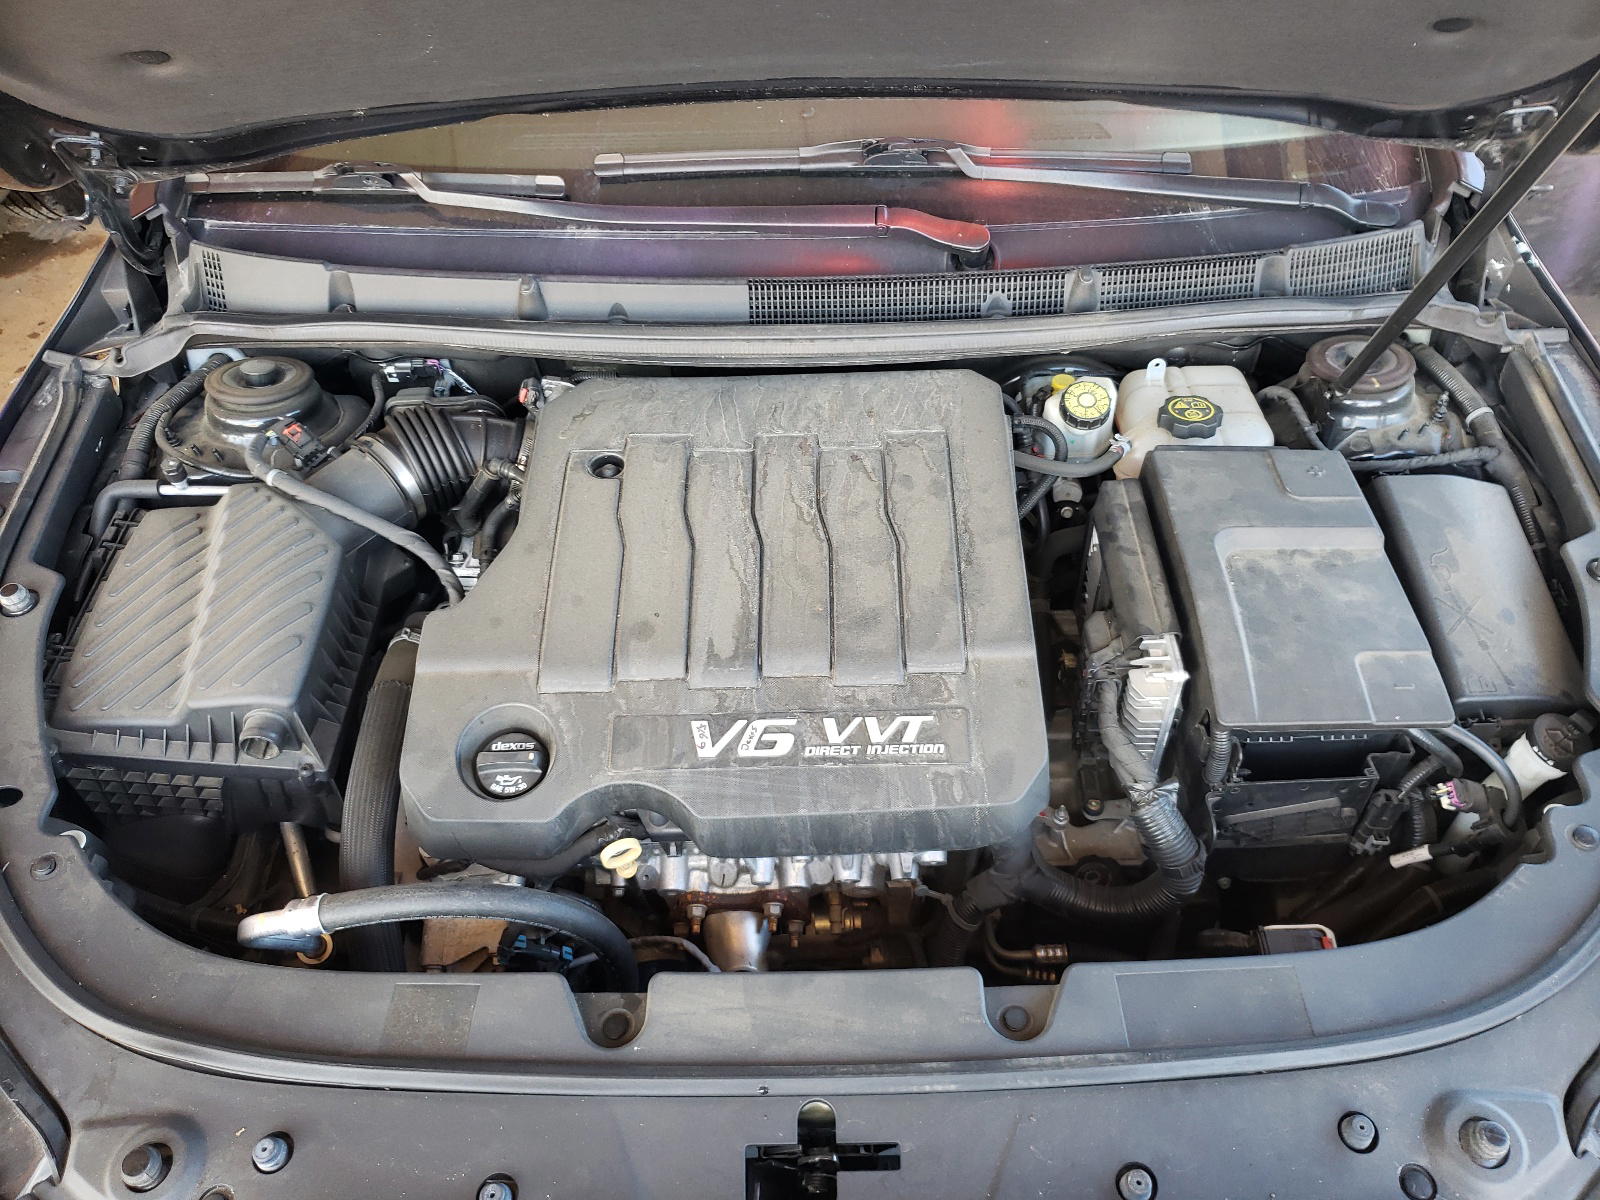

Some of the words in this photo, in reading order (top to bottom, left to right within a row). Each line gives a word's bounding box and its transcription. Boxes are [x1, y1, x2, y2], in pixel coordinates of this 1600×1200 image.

[690, 719, 798, 758] V6
[822, 715, 935, 743] VVT
[491, 741, 536, 751] dexos
[804, 745, 862, 756] DIRECT
[866, 743, 946, 755] INJECTION
[490, 783, 504, 793] SAE
[504, 782, 528, 793] 5W-30
